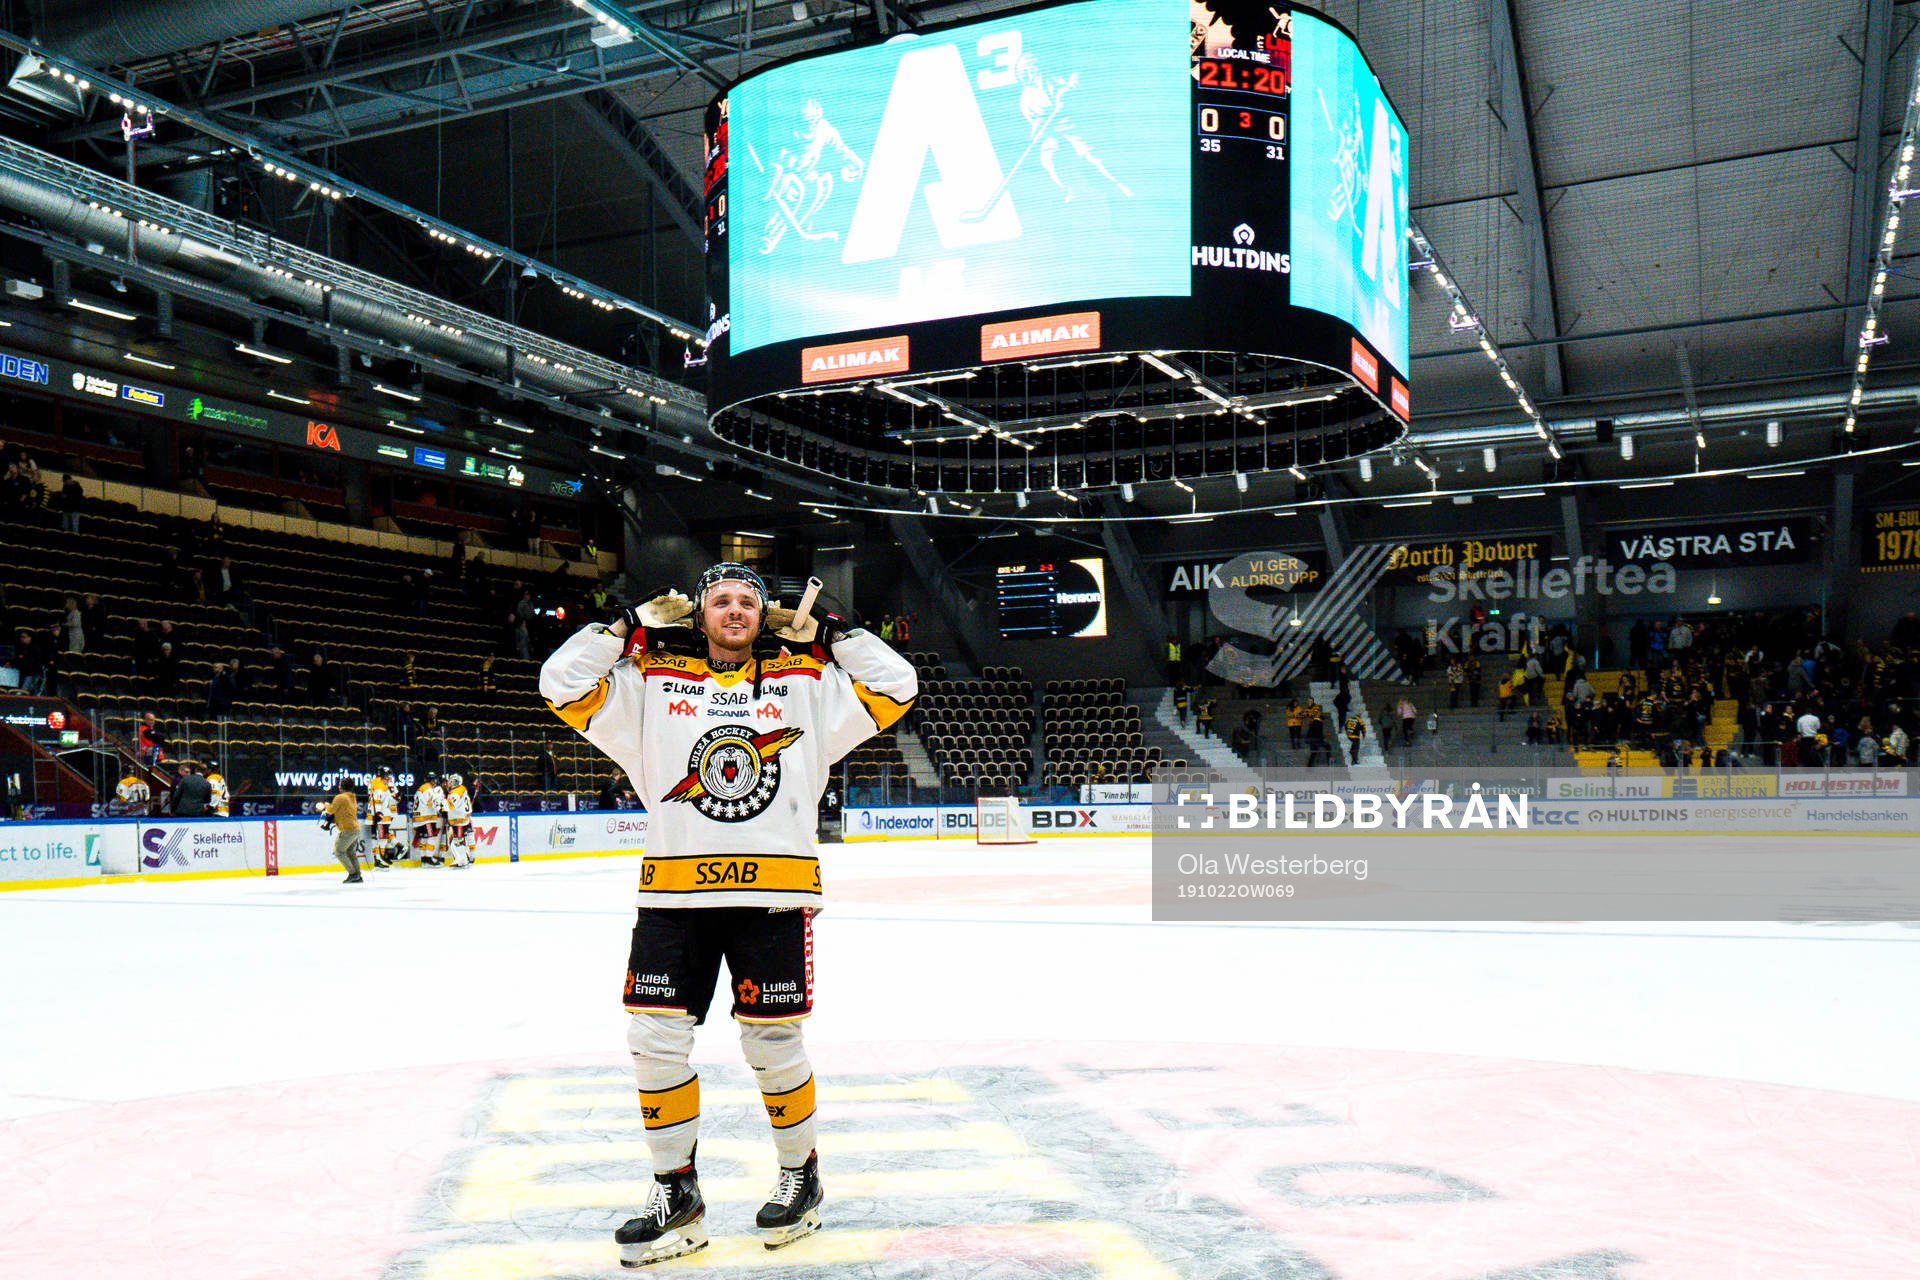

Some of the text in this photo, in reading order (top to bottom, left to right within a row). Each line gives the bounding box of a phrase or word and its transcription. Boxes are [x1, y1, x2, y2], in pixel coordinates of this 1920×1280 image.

[1217, 48, 1271, 63] LOCAL TIME
[1200, 61, 1285, 95] 21:20
[1200, 107, 1285, 141] 0 3 0
[1200, 138, 1285, 160] 35 31
[1191, 245, 1290, 274] HULTDINS
[991, 323, 1090, 350] ALIMAK
[809, 347, 900, 372] ALIMAK
[306, 420, 341, 452] ICA
[1620, 526, 1796, 560] VÄSTRA STÅ
[1386, 540, 1539, 571] North Power
[1249, 558, 1298, 573] VI GER
[1169, 563, 1225, 592] AIK
[1229, 571, 1319, 588] ALDRIG UPP
[1427, 612, 1547, 655] Kraft
[650, 655, 688, 668] SSAB
[673, 682, 705, 696] LKAB
[762, 684, 788, 697] LKAB
[710, 692, 748, 706] SSAB
[668, 699, 699, 717] MAX
[706, 708, 751, 718] SCANIA
[756, 702, 783, 721] MAX
[710, 727, 754, 740] HOCKEY
[1559, 782, 1650, 798] Selins.nu
[1702, 786, 1768, 798] EXPERTEN
[1784, 776, 1901, 792] HOLMSTRÖM
[1032, 810, 1098, 828] BDX
[1607, 808, 1688, 822] HULTDINS
[1694, 805, 1793, 821] energiservice
[1806, 808, 1909, 823] Handelsbanken
[556, 823, 577, 834] Svensk
[875, 815, 935, 831] Indexator
[193, 830, 243, 845] Skellefteå
[23, 846, 41, 861] to
[44, 841, 78, 860] life.
[193, 848, 219, 859] Kraft
[695, 861, 759, 885] SSAB
[635, 972, 670, 985] Luleå
[763, 980, 797, 993] Luleå
[635, 985, 676, 997] Energi
[763, 992, 804, 1005] Energi
